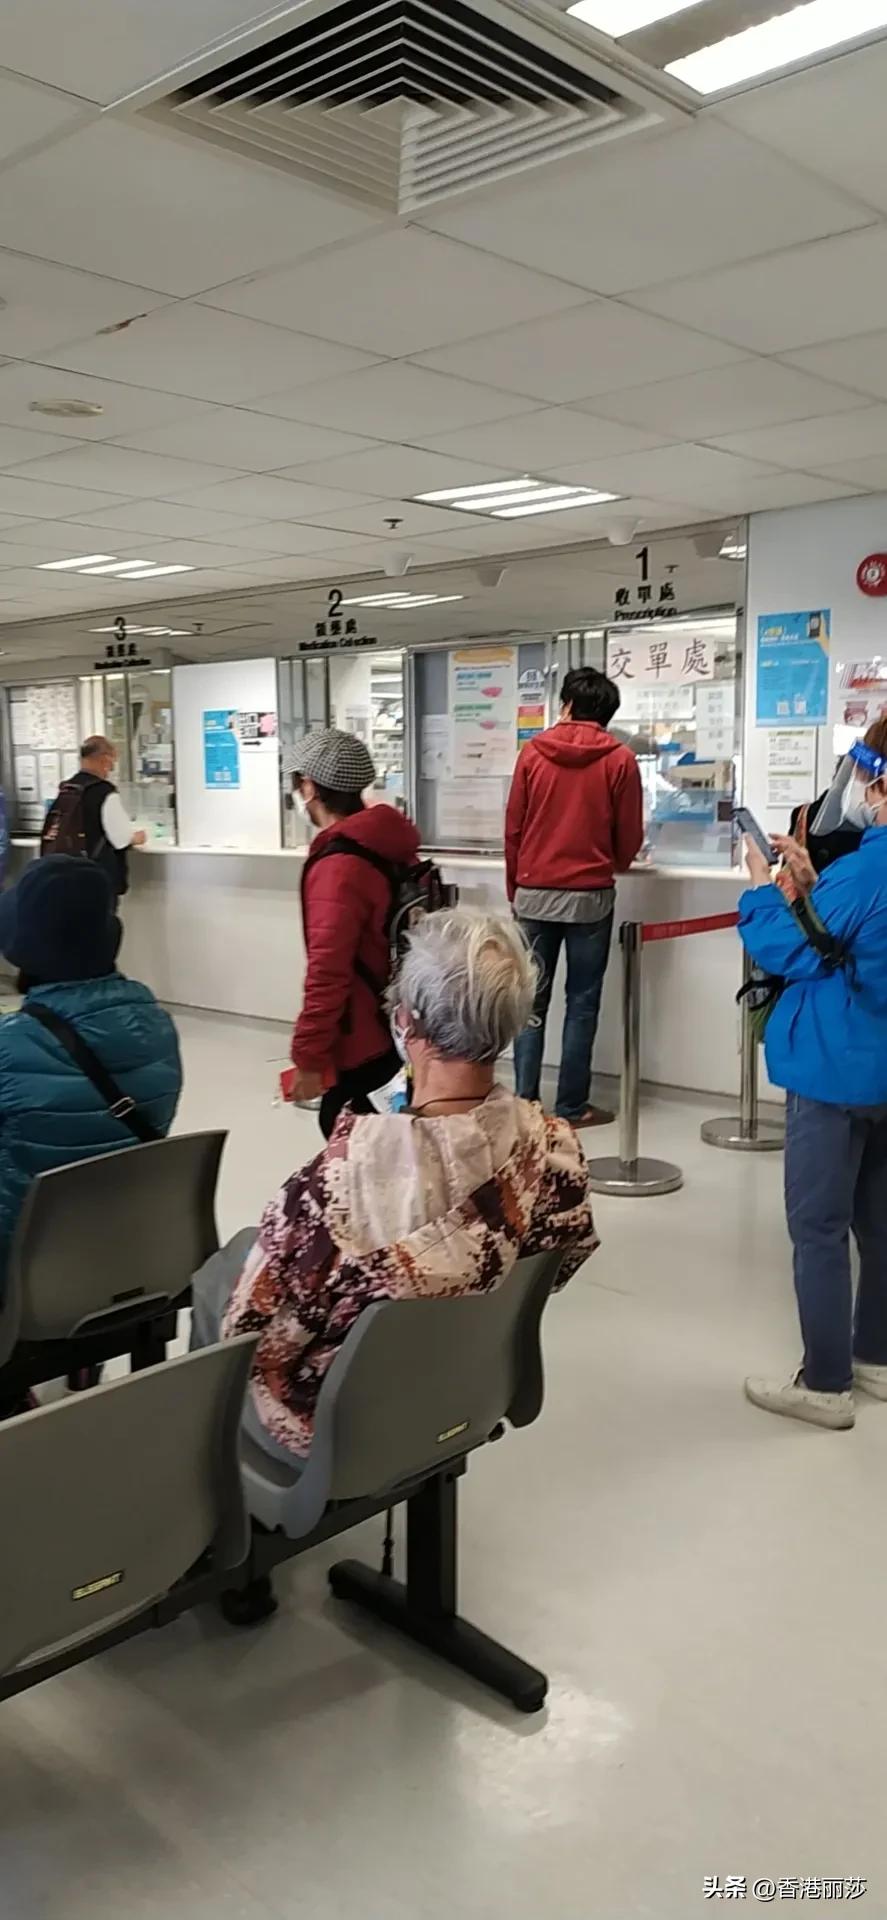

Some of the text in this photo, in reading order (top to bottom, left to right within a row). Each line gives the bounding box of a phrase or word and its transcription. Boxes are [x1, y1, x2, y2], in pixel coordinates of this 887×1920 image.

[635, 546, 648, 581] 1
[328, 588, 343, 617] 2
[114, 616, 126, 641] 3
[608, 638, 711, 680] 交單處
